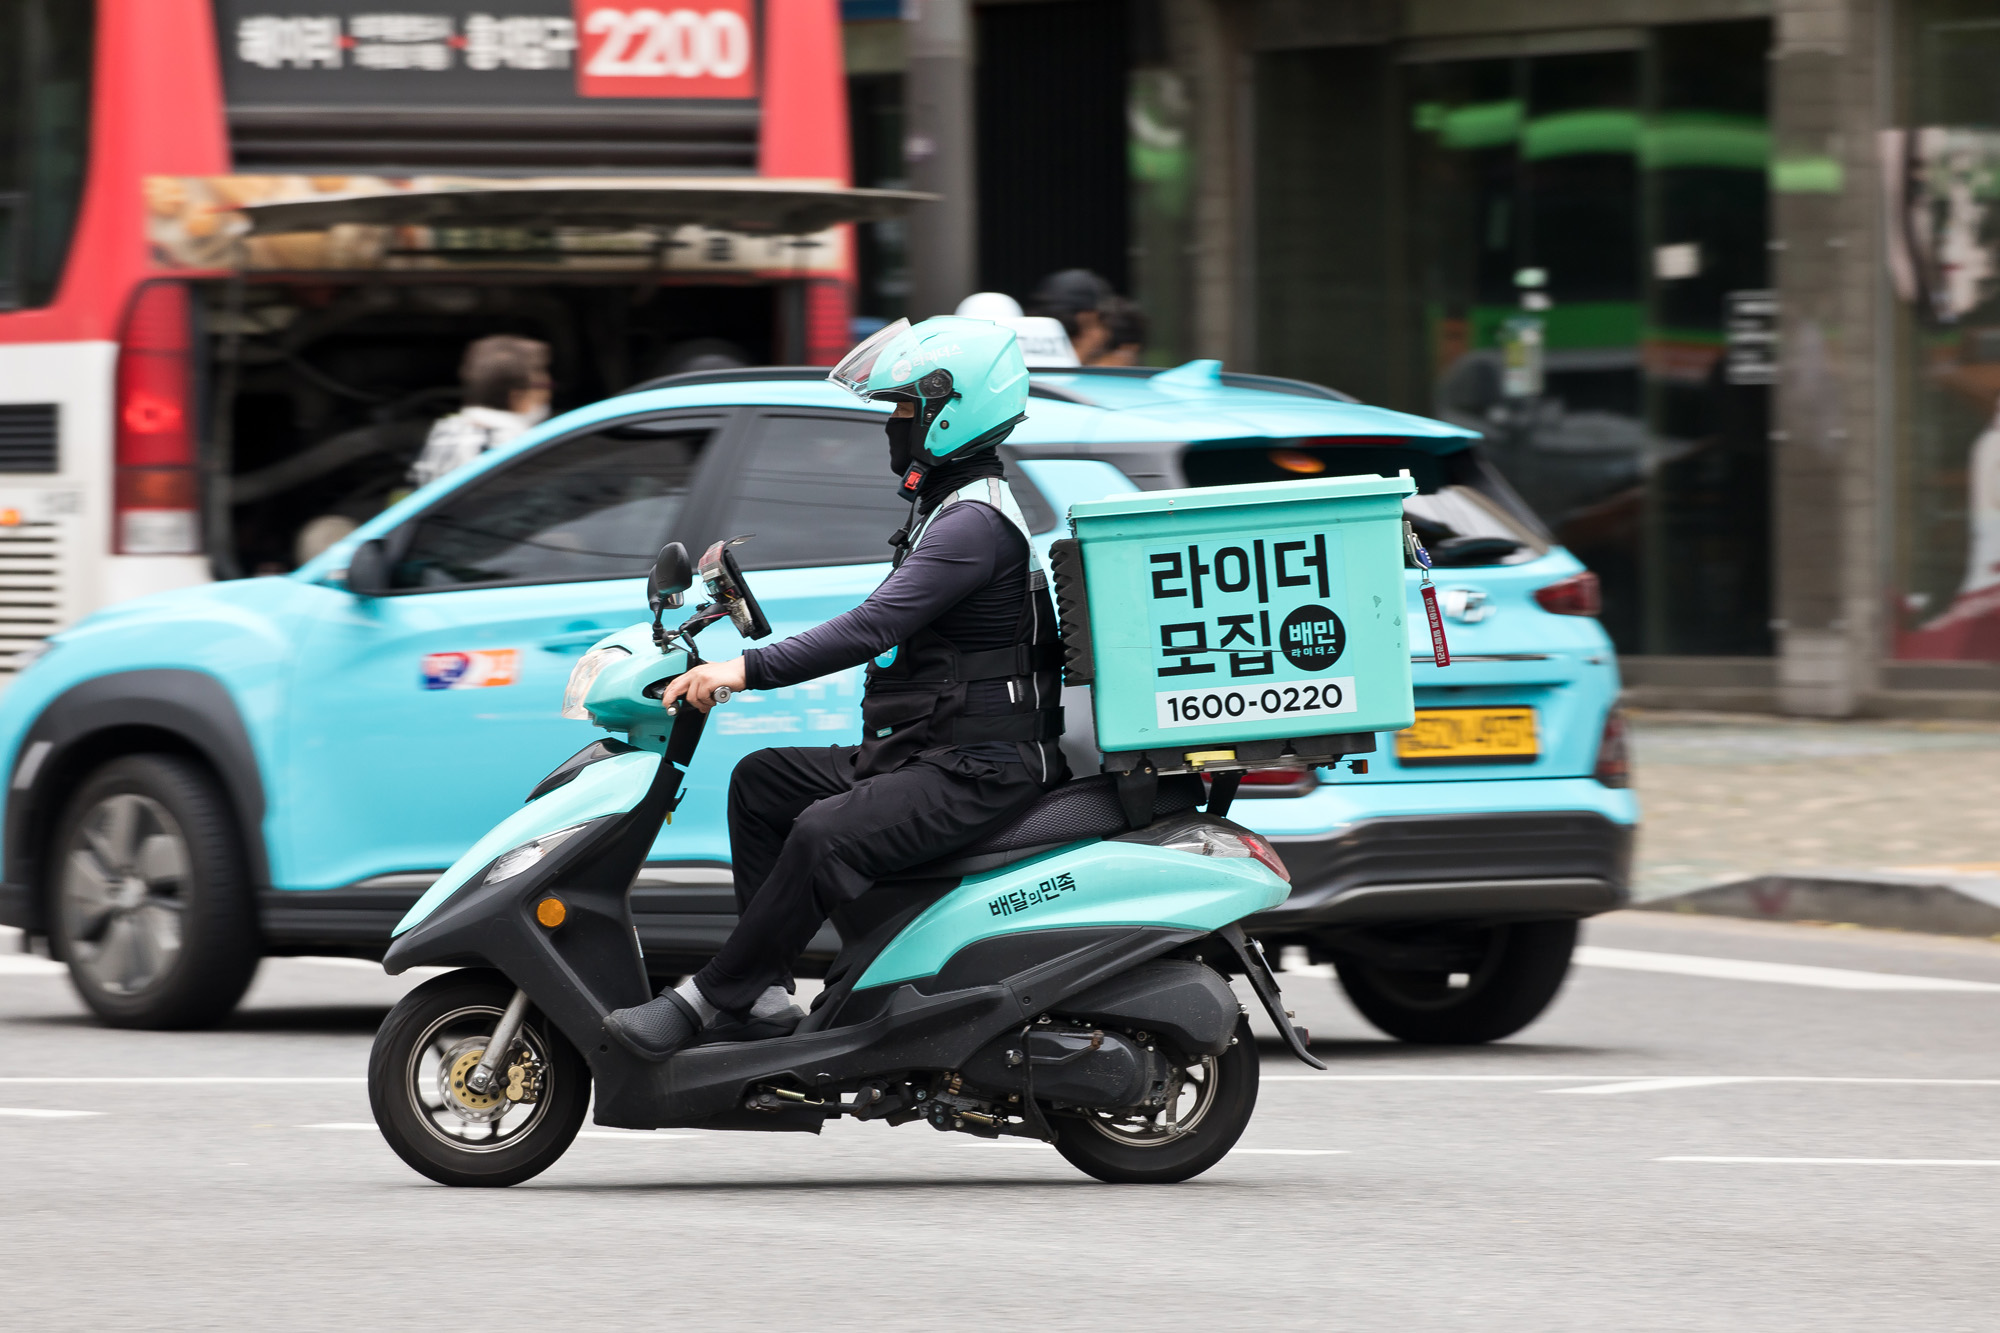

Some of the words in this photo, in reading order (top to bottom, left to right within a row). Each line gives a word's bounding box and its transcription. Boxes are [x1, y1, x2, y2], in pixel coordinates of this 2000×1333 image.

[583, 8, 750, 79] 2200
[911, 344, 964, 367] 라이더스
[1149, 533, 1331, 609] 라이더
[1157, 610, 1274, 678] 모집
[1288, 619, 1336, 646] 배민
[1291, 645, 1337, 657] 라이더스
[1167, 683, 1343, 722] 1600-0220
[988, 871, 1077, 917] 배달의민족
